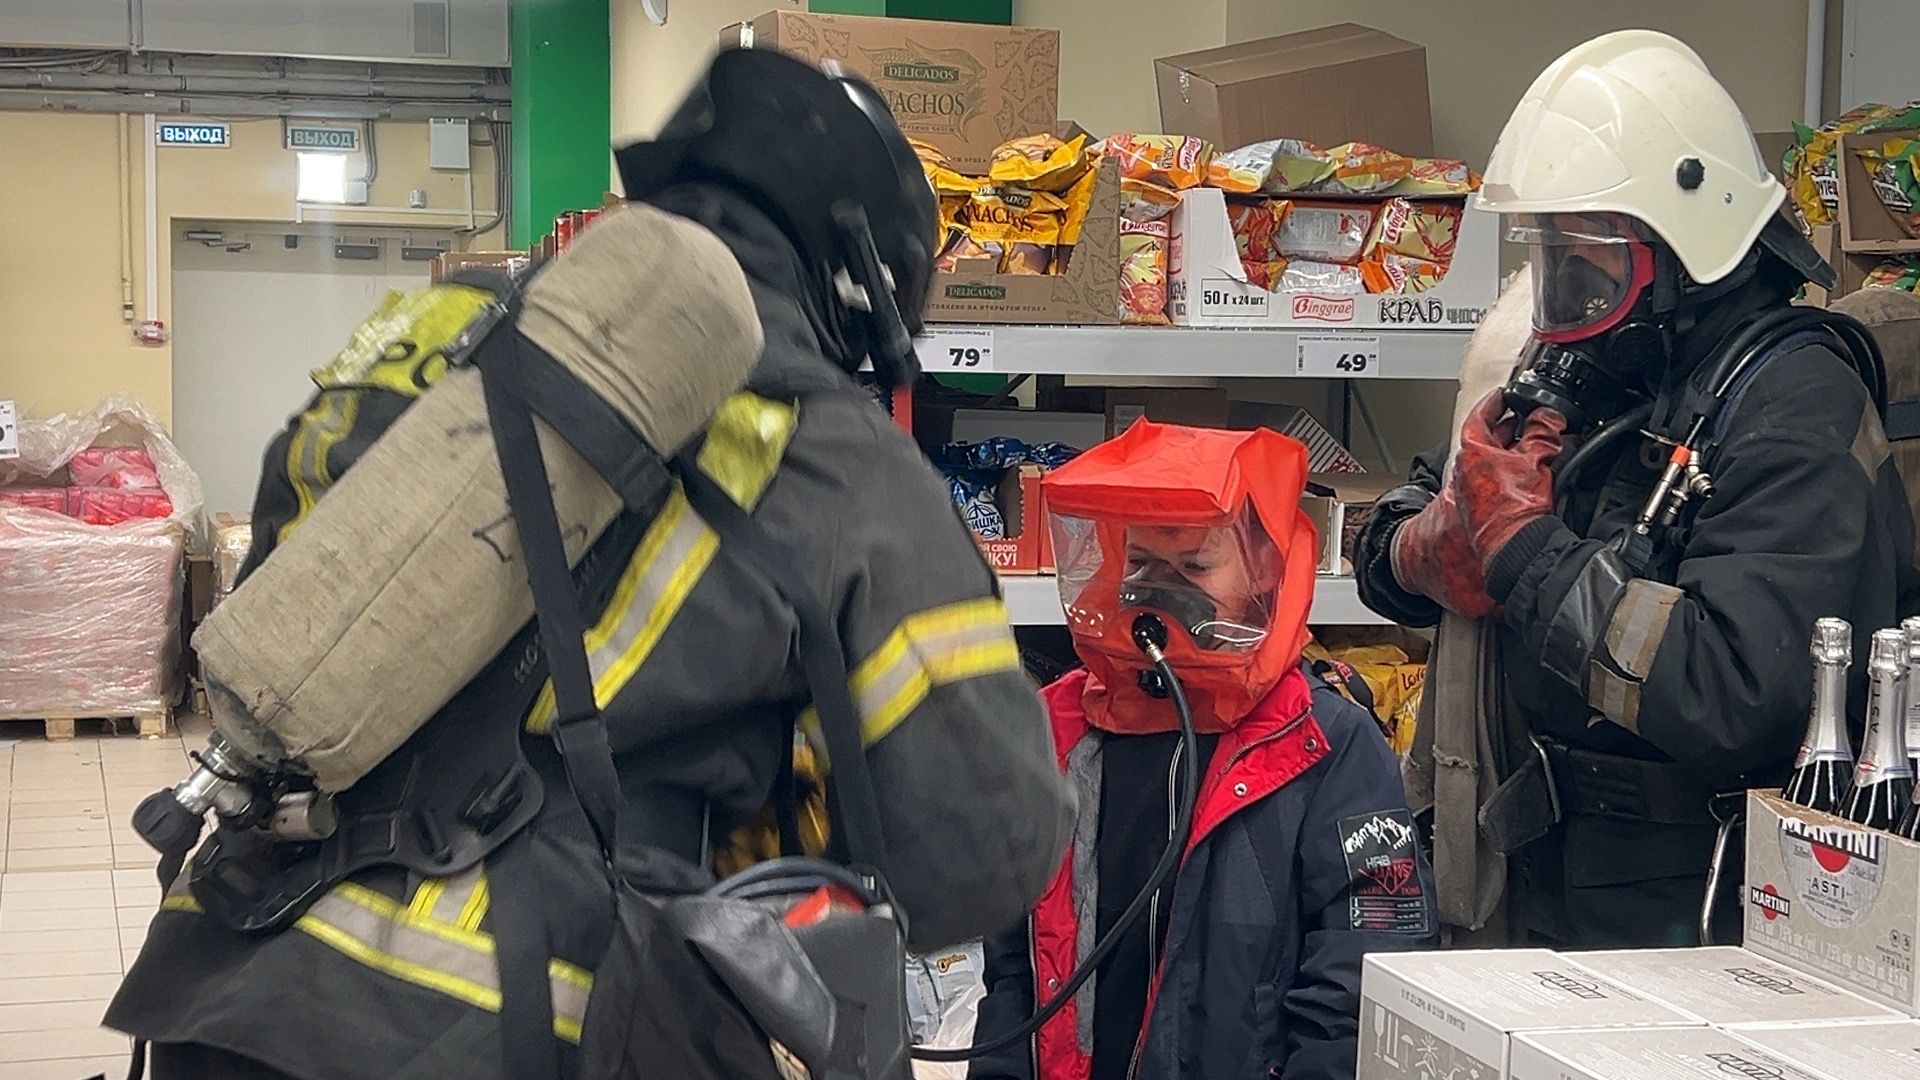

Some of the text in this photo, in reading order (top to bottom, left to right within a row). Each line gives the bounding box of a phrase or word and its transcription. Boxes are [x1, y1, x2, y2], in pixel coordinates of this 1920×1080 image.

[888, 66, 955, 80] DELICADOS
[163, 127, 224, 144] ВЫХОД
[293, 131, 352, 147] ВЫХОД
[949, 287, 1003, 298] DELICADOS
[1203, 290, 1220, 305] 50
[1240, 295, 1249, 305] 24
[1294, 298, 1352, 317] Binggrae
[1380, 298, 1443, 323] КРАБ
[949, 347, 980, 367] 79
[1336, 353, 1367, 372] 49
[967, 514, 1004, 531] ИШКА
[991, 543, 1018, 553] СВОЮ
[1869, 678, 1882, 734] ASTI
[1811, 877, 1845, 900] ASTI
[1752, 888, 1790, 915] MARTINI
